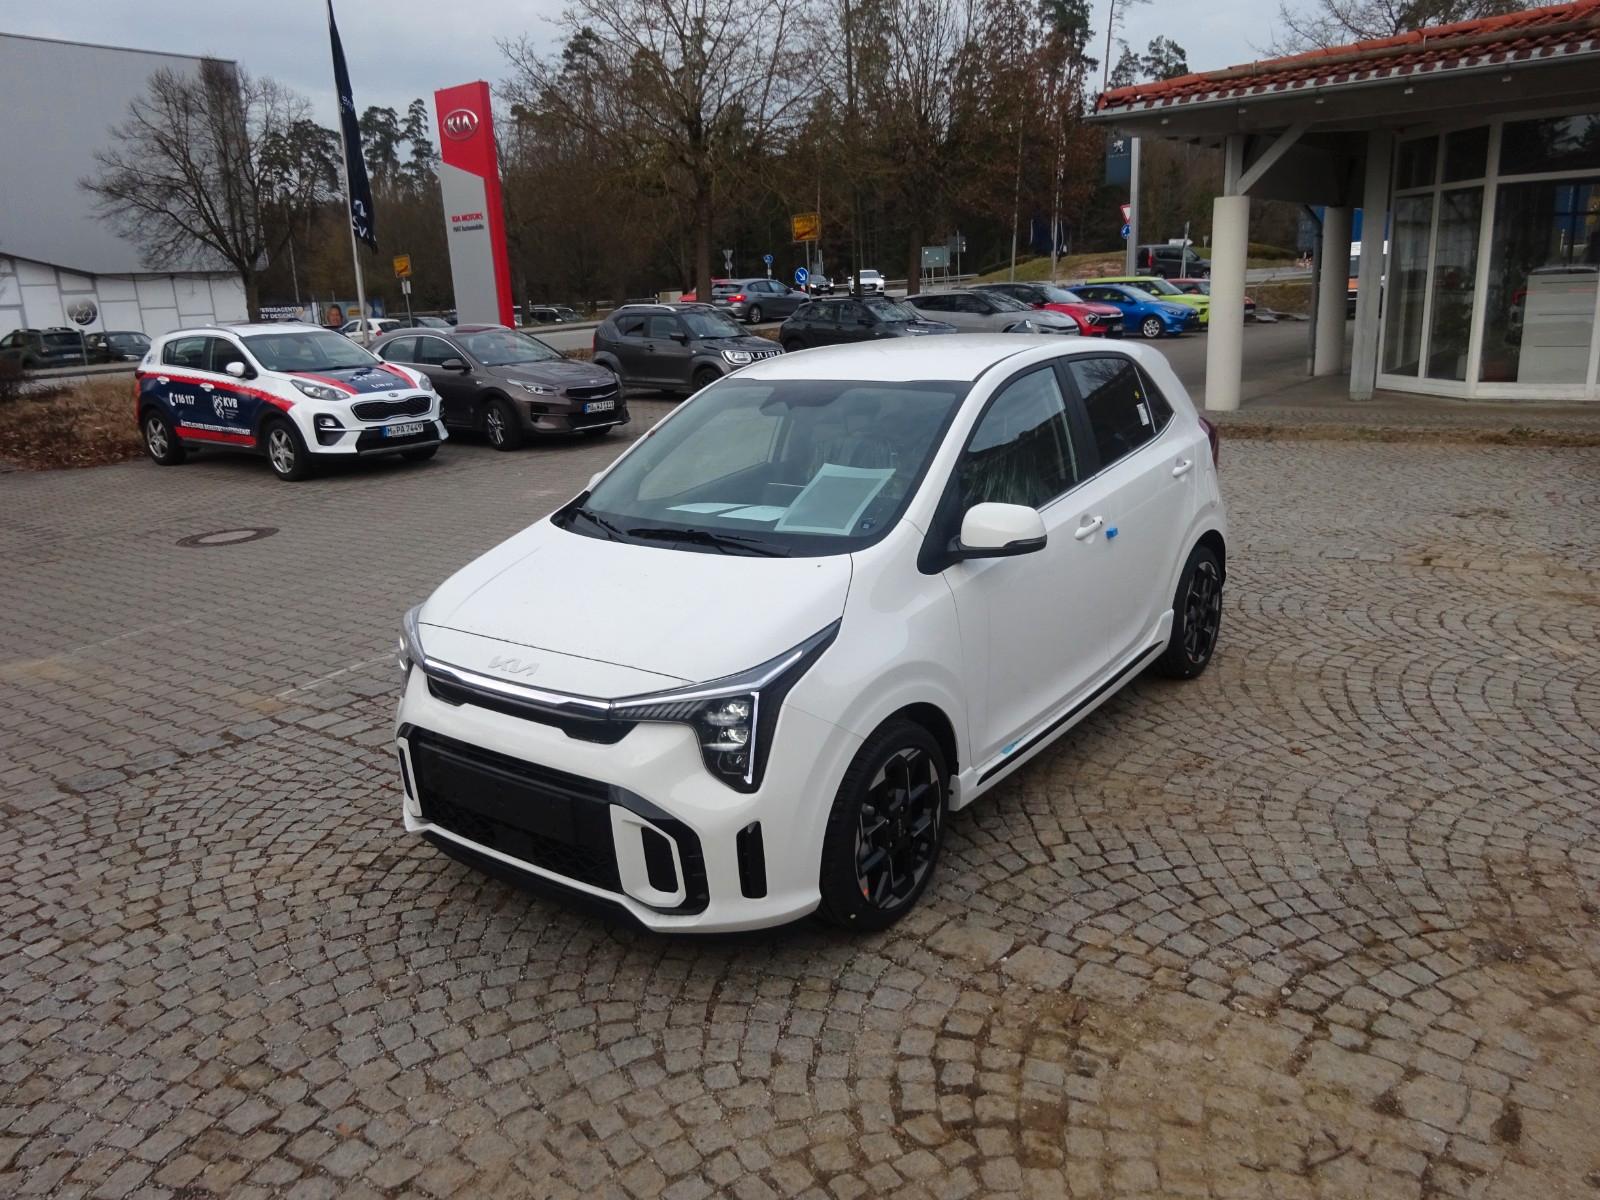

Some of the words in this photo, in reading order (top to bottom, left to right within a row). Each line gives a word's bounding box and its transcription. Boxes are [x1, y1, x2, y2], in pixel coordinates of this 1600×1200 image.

[447, 115, 473, 133] KIA
[174, 393, 186, 404] 116
[185, 394, 195, 405] 117
[223, 396, 238, 408] KVB
